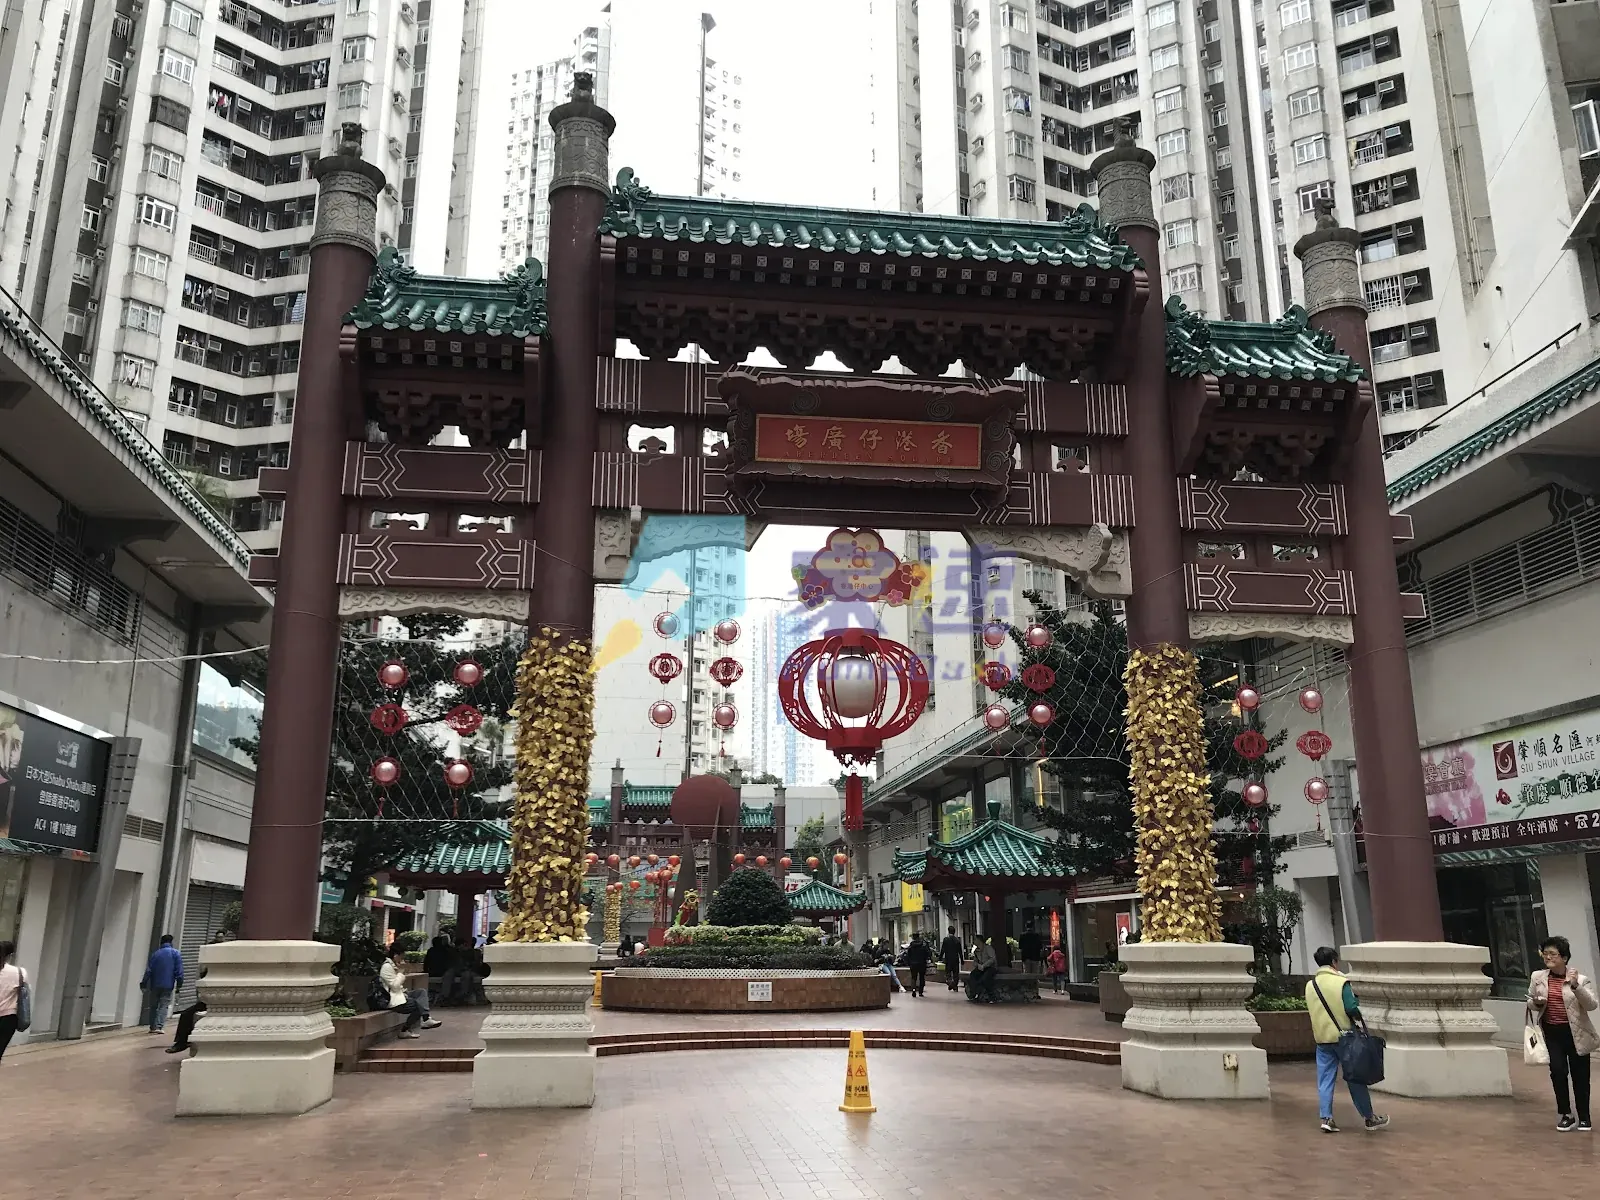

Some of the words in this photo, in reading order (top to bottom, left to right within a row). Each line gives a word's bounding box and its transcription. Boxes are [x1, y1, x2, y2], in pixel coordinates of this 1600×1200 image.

[1520, 762, 1534, 774] SIU
[1537, 758, 1559, 771] SHUN
[1561, 750, 1596, 766] VILLAGE
[34, 818, 46, 830] AC4
[1516, 818, 1559, 837] 全年酒席
